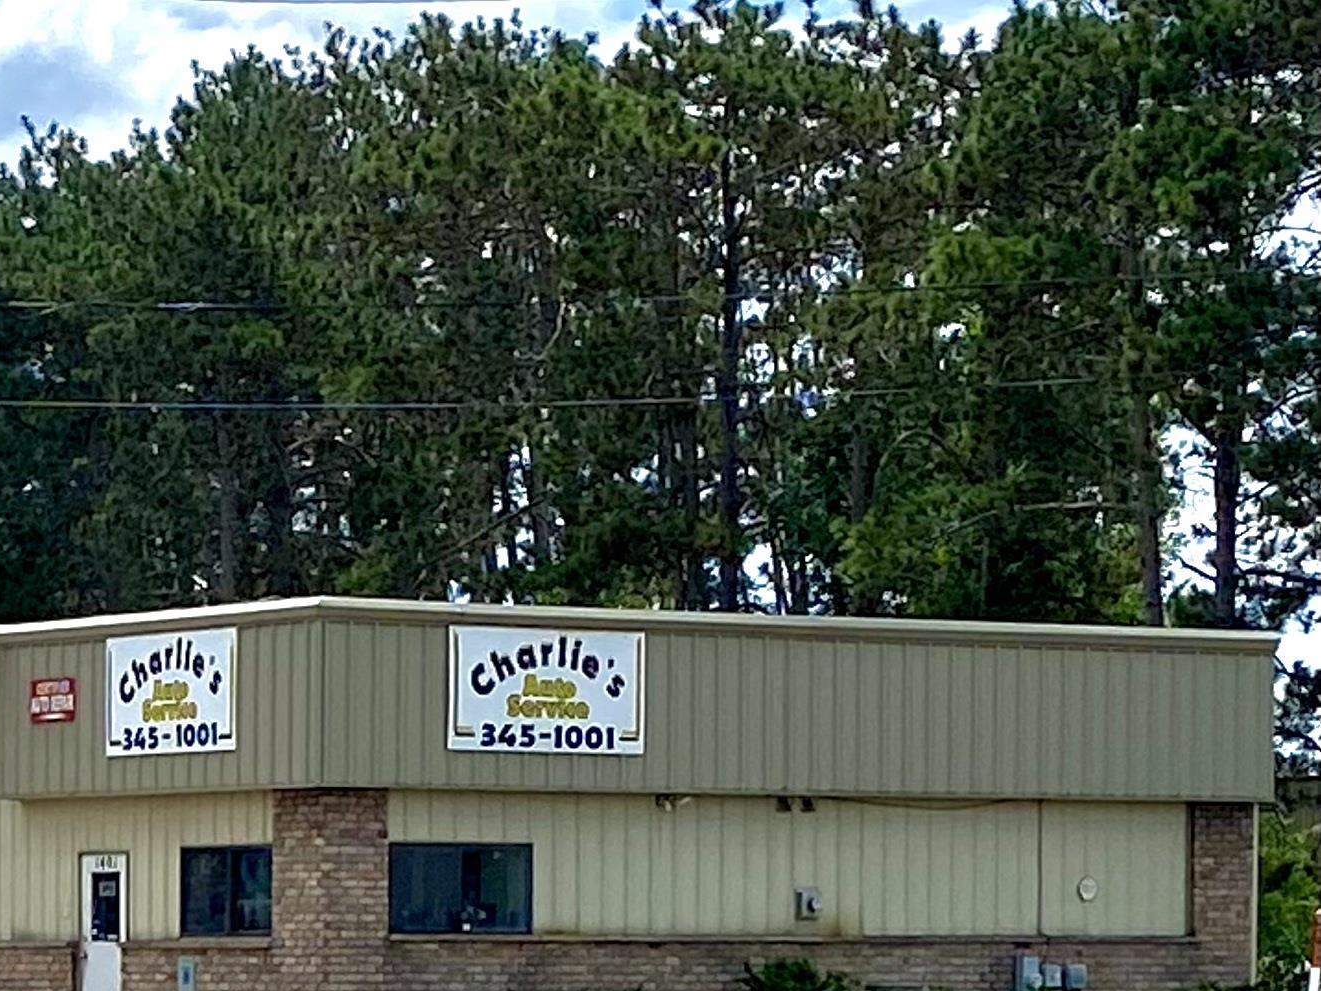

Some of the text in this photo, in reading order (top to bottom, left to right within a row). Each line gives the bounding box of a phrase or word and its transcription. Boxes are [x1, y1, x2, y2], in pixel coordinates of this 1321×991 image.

[119, 636, 223, 704] Charlie's
[471, 635, 626, 699] Charlie's
[523, 673, 578, 699] Auto
[506, 694, 591, 720] Service
[123, 722, 218, 751] 345-1001
[480, 723, 615, 751] 345-1001
